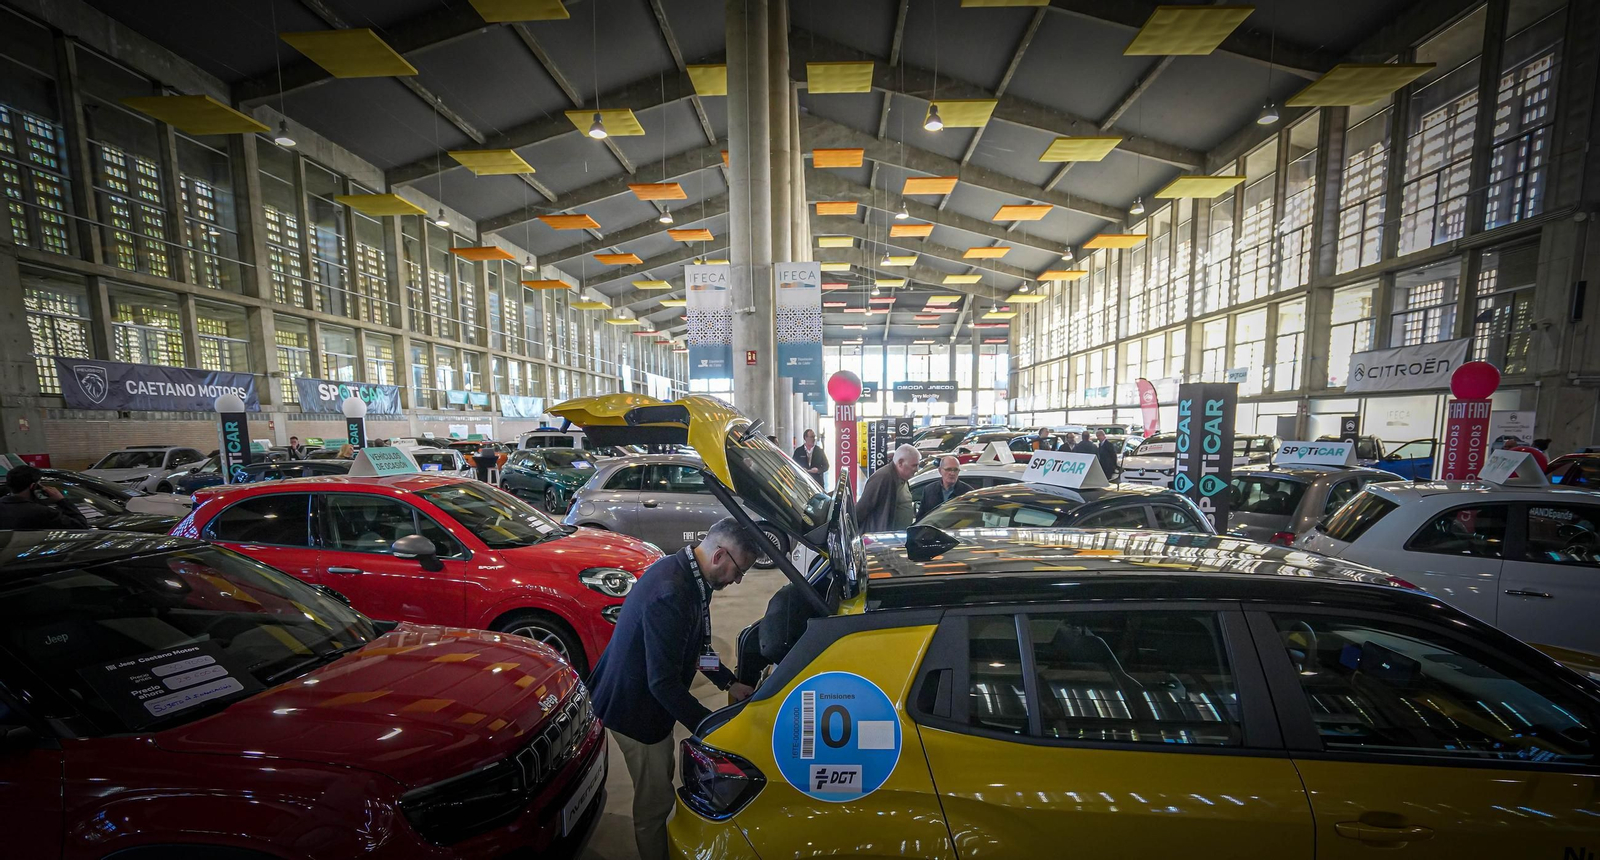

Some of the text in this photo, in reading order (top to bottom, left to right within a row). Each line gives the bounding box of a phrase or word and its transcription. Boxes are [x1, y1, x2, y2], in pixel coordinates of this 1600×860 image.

[689, 272, 726, 283] IFECA
[779, 270, 816, 281] IFECA
[125, 379, 196, 397] CAETANO
[835, 405, 856, 421] FIAT
[1449, 402, 1467, 419] FIAT
[1468, 402, 1491, 419] FIAT
[1447, 424, 1460, 470] MOTORS
[1468, 424, 1482, 470] MOTORS
[683, 531, 695, 540] FIAT
[45, 633, 69, 645] Jeep
[118, 645, 200, 668] Jeep Caetano Motors
[130, 672, 150, 681] Precio
[131, 684, 162, 697] Precio
[138, 688, 165, 700] ahora
[537, 693, 560, 712] Jeep
[821, 704, 852, 749] 0
[830, 771, 857, 784] DGT
